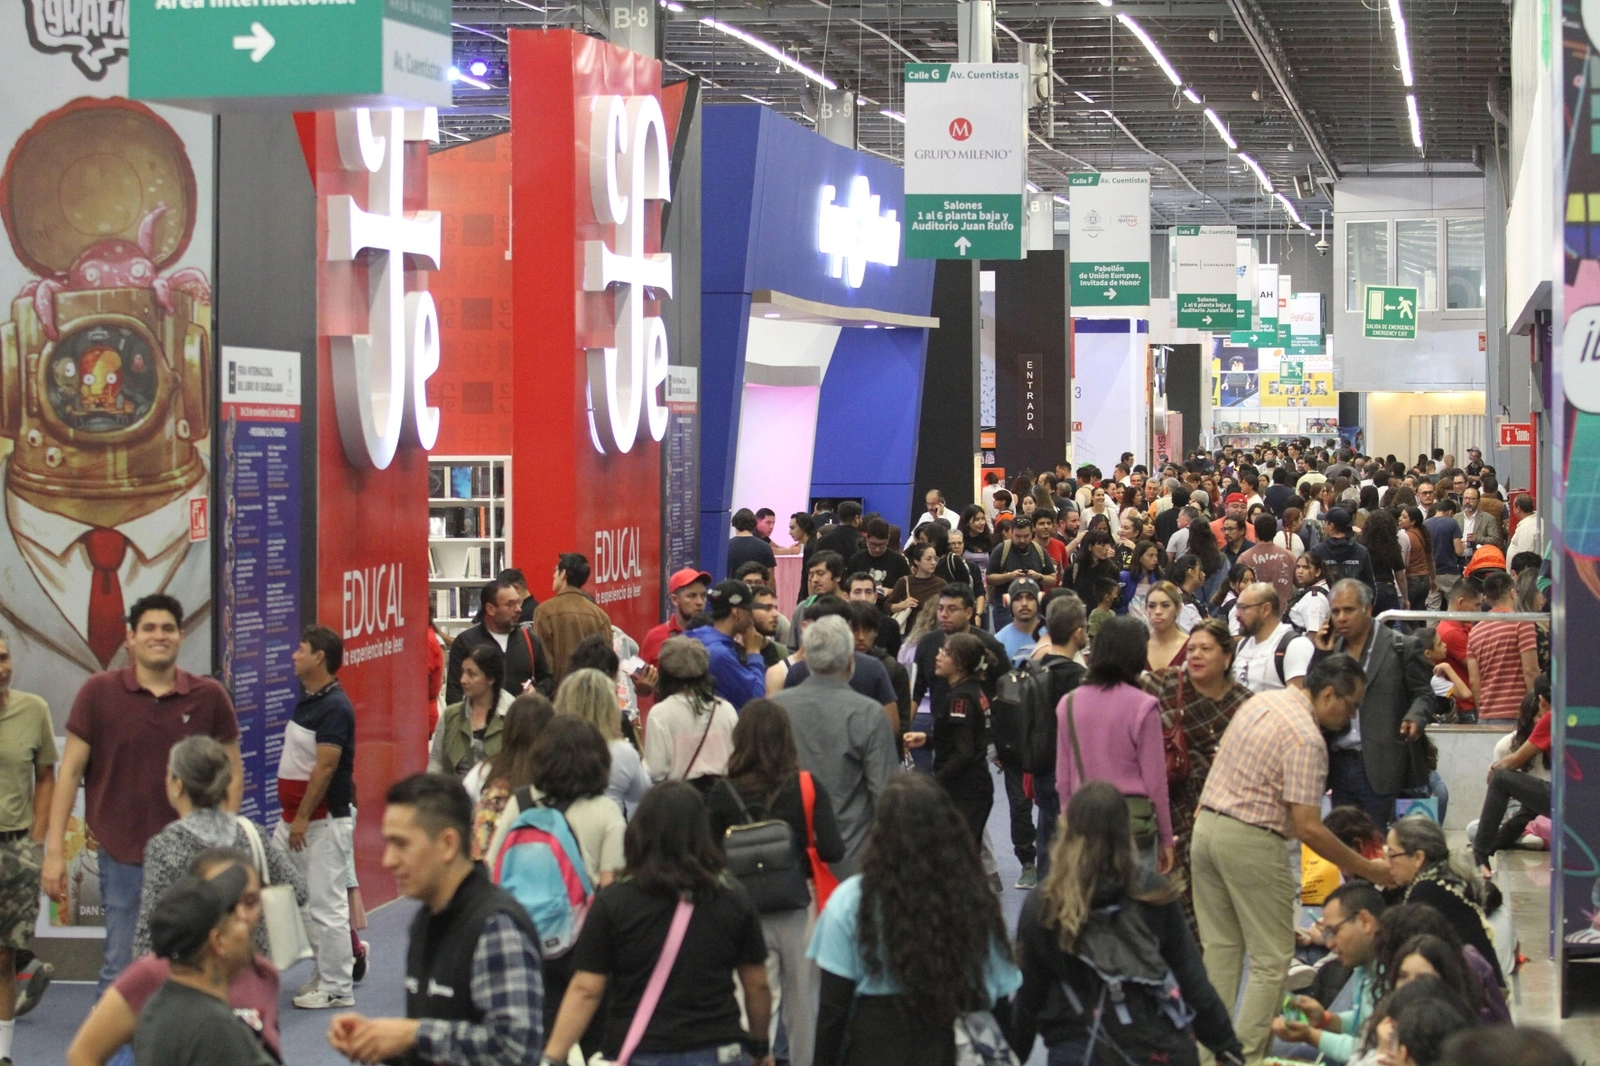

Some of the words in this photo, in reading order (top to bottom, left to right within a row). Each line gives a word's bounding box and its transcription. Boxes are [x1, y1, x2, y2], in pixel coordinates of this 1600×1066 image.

[908, 71, 929, 79] Calle
[932, 70, 939, 79] G
[950, 71, 964, 79] Av.
[967, 71, 1019, 79] Cuentistas
[952, 122, 969, 136] M
[915, 150, 956, 159] GRUPO
[944, 201, 982, 210] Salones
[918, 212, 923, 220] 1
[926, 212, 934, 220] al
[937, 212, 942, 220] 6
[945, 212, 977, 222] planta
[979, 211, 1000, 222] baja
[1003, 213, 1008, 222] y
[912, 222, 958, 230] Auditorio
[961, 222, 985, 230] Juan
[988, 222, 1014, 230] Rulfo
[1026, 361, 1034, 430] ENTRADA
[1075, 387, 1081, 399] 3
[595, 526, 642, 584] EDUCAL
[344, 563, 404, 640] EDUCAL
[601, 585, 626, 606] experiencia
[344, 647, 349, 666] la
[350, 639, 383, 668] experiencia
[384, 636, 392, 655] de
[393, 635, 404, 653] leer
[80, 905, 98, 916] DAN
